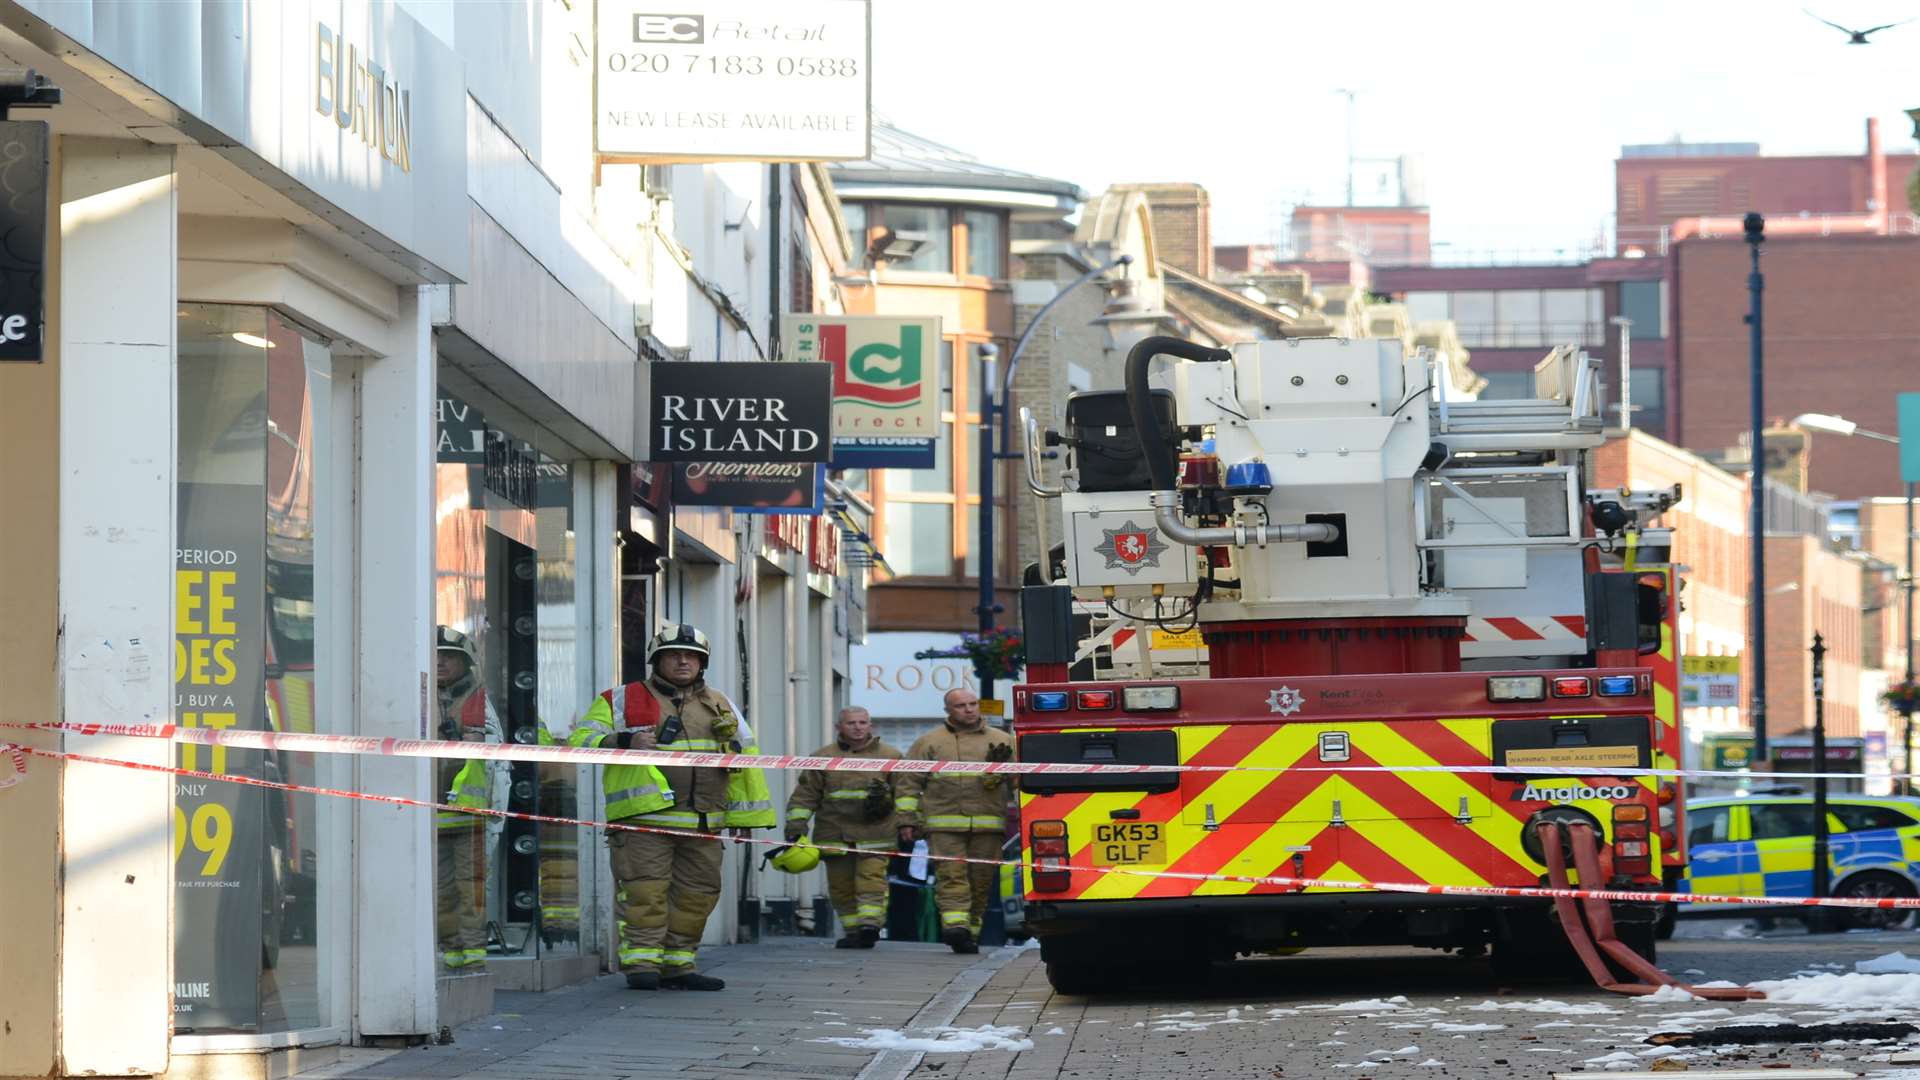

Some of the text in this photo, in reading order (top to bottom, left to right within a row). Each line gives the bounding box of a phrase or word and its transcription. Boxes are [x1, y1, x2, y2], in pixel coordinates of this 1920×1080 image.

[636, 15, 826, 42] BC Retail
[608, 52, 857, 77] 020 7183 0588
[316, 21, 410, 175] BURTON
[608, 111, 857, 131] NEW LEASE AVAILABLE
[661, 395, 789, 421] RIVER
[661, 425, 819, 451] ISLAND
[686, 461, 802, 479] Thorntons
[176, 549, 237, 565] PERIOD
[189, 695, 217, 706] BUY
[223, 695, 234, 706] A
[1521, 784, 1629, 804] Angloco
[1097, 824, 1159, 842] GK53
[1106, 844, 1152, 861] GLF
